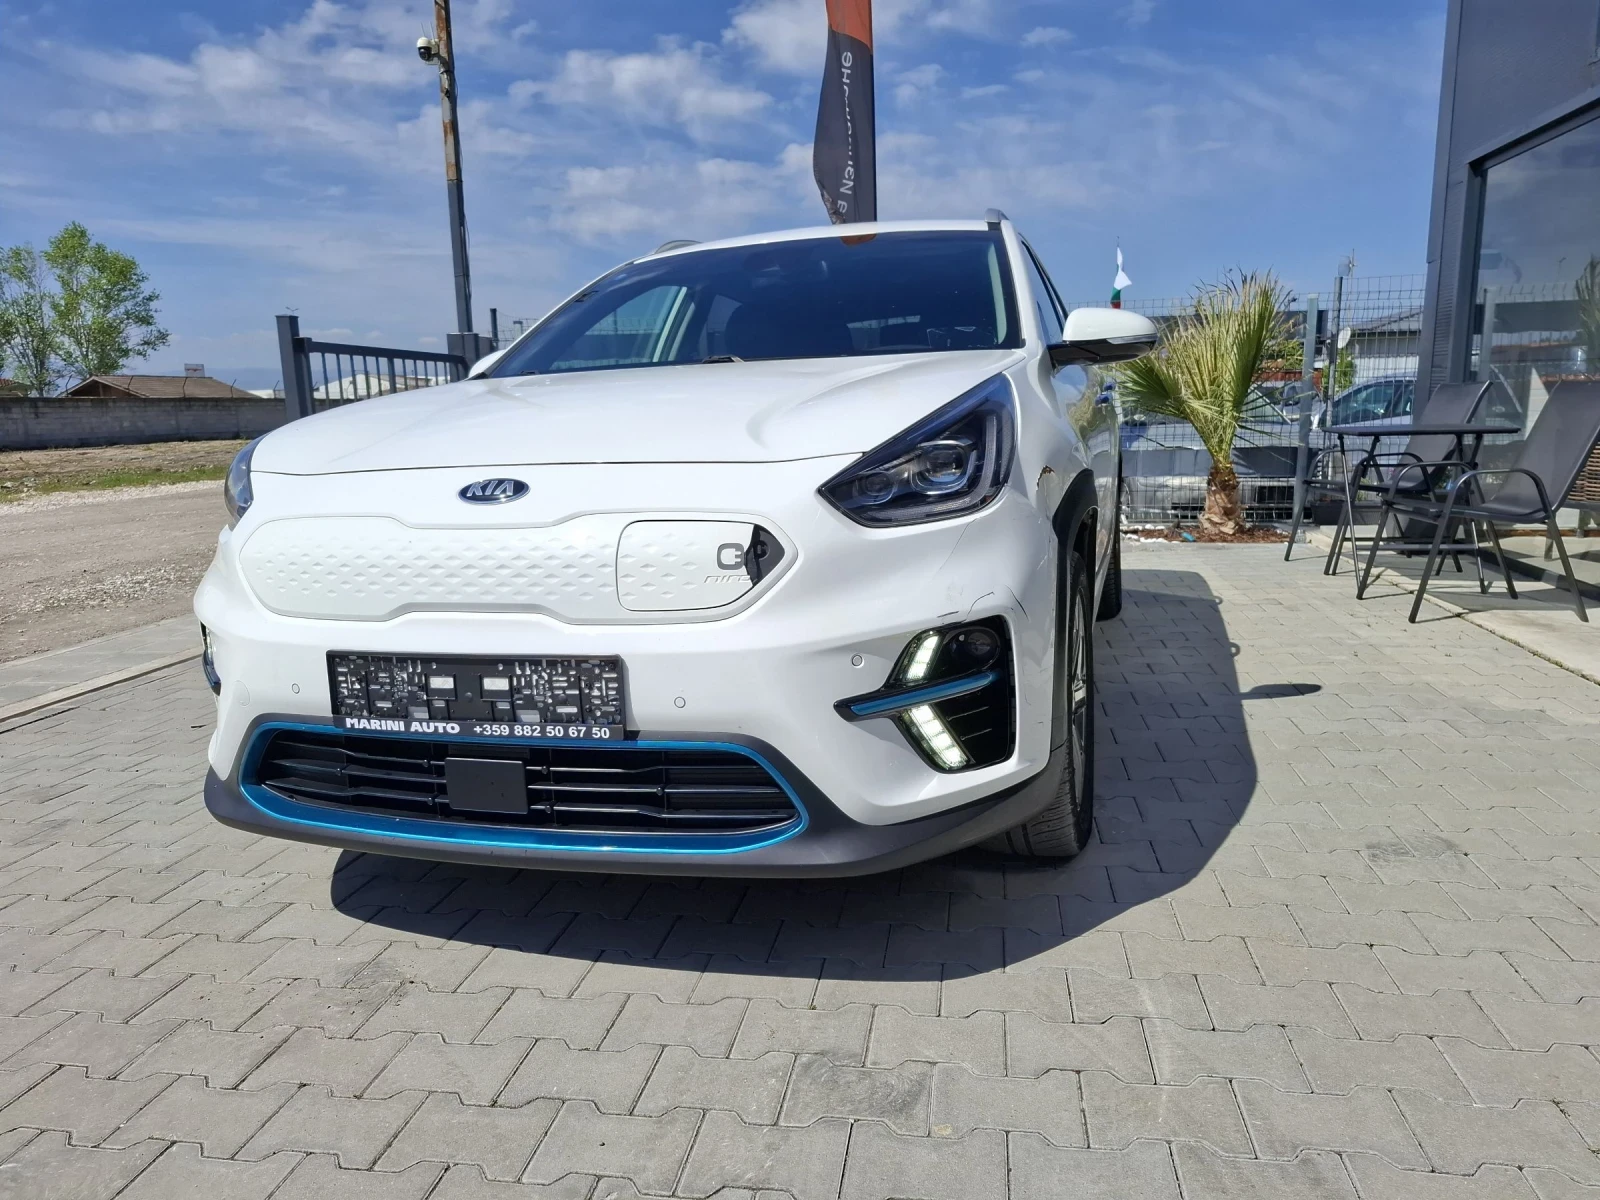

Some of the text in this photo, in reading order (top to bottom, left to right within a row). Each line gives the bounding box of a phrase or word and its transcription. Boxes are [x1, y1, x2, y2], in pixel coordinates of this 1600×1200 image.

[466, 480, 515, 497] KIA
[345, 717, 610, 739] MARINI AUTO +359 882 50 67 50
